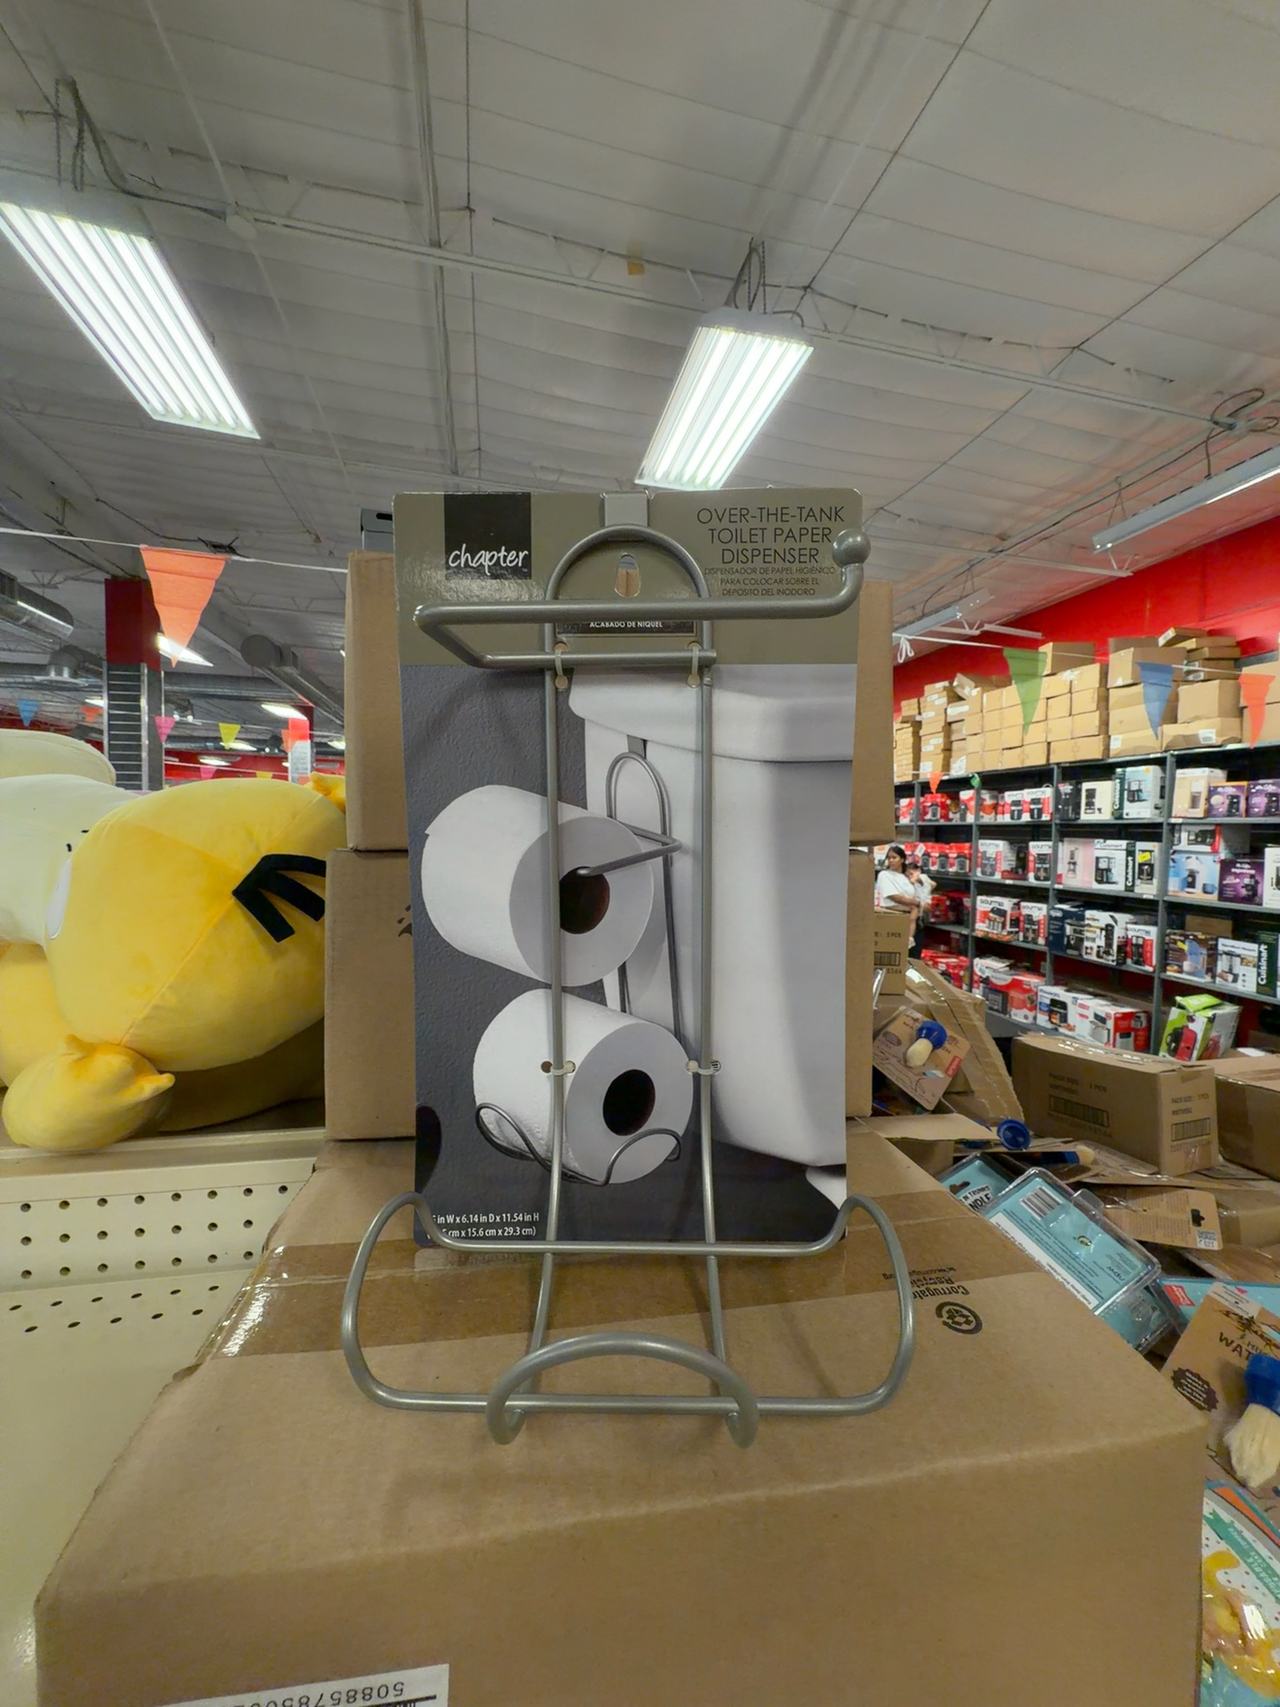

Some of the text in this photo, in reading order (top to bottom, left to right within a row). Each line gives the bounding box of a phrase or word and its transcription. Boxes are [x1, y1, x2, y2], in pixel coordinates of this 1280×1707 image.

[697, 506, 845, 525] OVER-THE-TANK
[708, 527, 832, 544] TOILET PAPER
[448, 543, 529, 576] chapter
[721, 547, 820, 565] DISPENSER
[704, 566, 758, 575] DISPENSADOR
[759, 566, 770, 575] DE
[771, 566, 793, 575] PAPEL
[720, 577, 819, 586] PARA COLOCAR SOBRE EL
[761, 588, 775, 596] DEL
[777, 587, 816, 596] INODORO
[1257, 944, 1268, 985] Cuisinart
[437, 1215, 445, 1224] in
[446, 1215, 455, 1223] W
[461, 1214, 479, 1223] 6.14
[480, 1214, 487, 1223] in
[489, 1214, 495, 1222] D
[502, 1213, 523, 1222] 11.54
[524, 1212, 532, 1222] in
[533, 1212, 539, 1222] H
[467, 1228, 484, 1237] 15.6
[504, 1227, 520, 1236] 29.3
[1218, 1332, 1254, 1361] WAT
